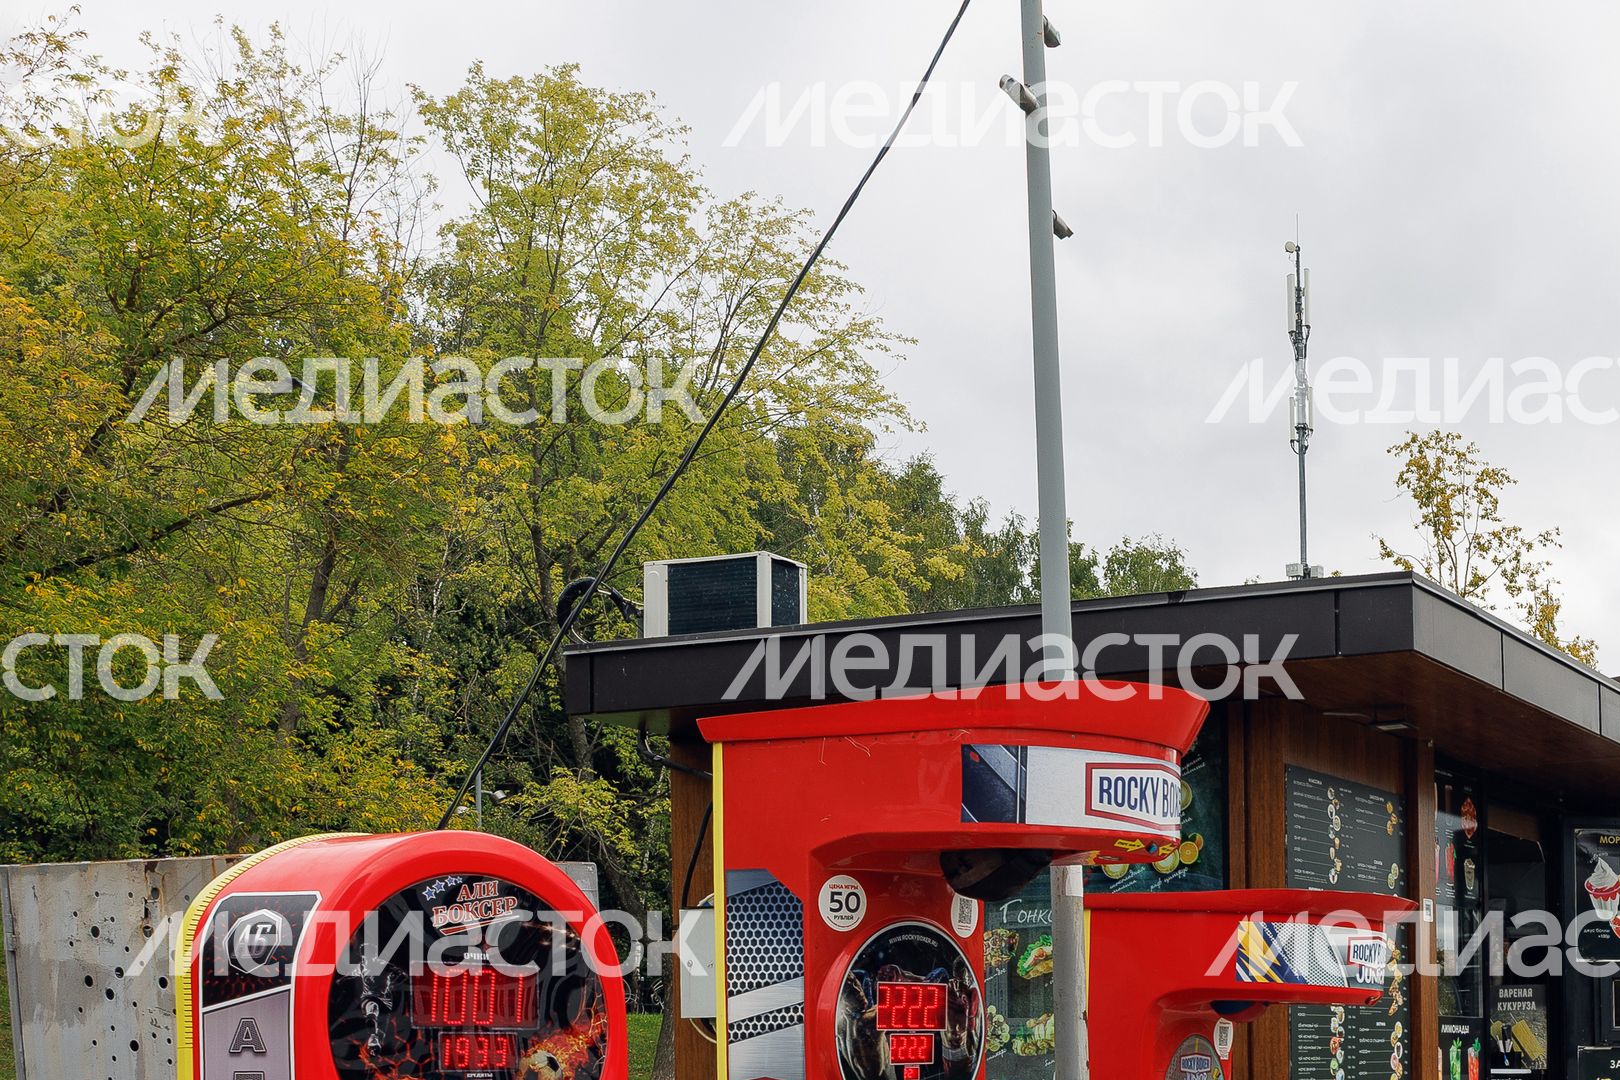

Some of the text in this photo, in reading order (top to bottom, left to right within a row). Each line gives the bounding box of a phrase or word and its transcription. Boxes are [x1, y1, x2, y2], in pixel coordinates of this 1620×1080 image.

[1099, 776, 1160, 816] ROCKY
[456, 880, 498, 902] АЛИ
[432, 896, 518, 928] БОКСЕР
[829, 891, 861, 914] 50
[888, 934, 939, 948] WWW.ROCKYBOXER.RU
[1353, 943, 1378, 963] ROCKY
[1498, 988, 1533, 998] ВАРЕНАЯ
[1497, 1001, 1537, 1011] КУКУРУЗА
[1441, 1024, 1470, 1034] ЛИМОНАДЫ
[443, 1037, 508, 1068] 1933
[1182, 1059, 1196, 1071] ROCKY
